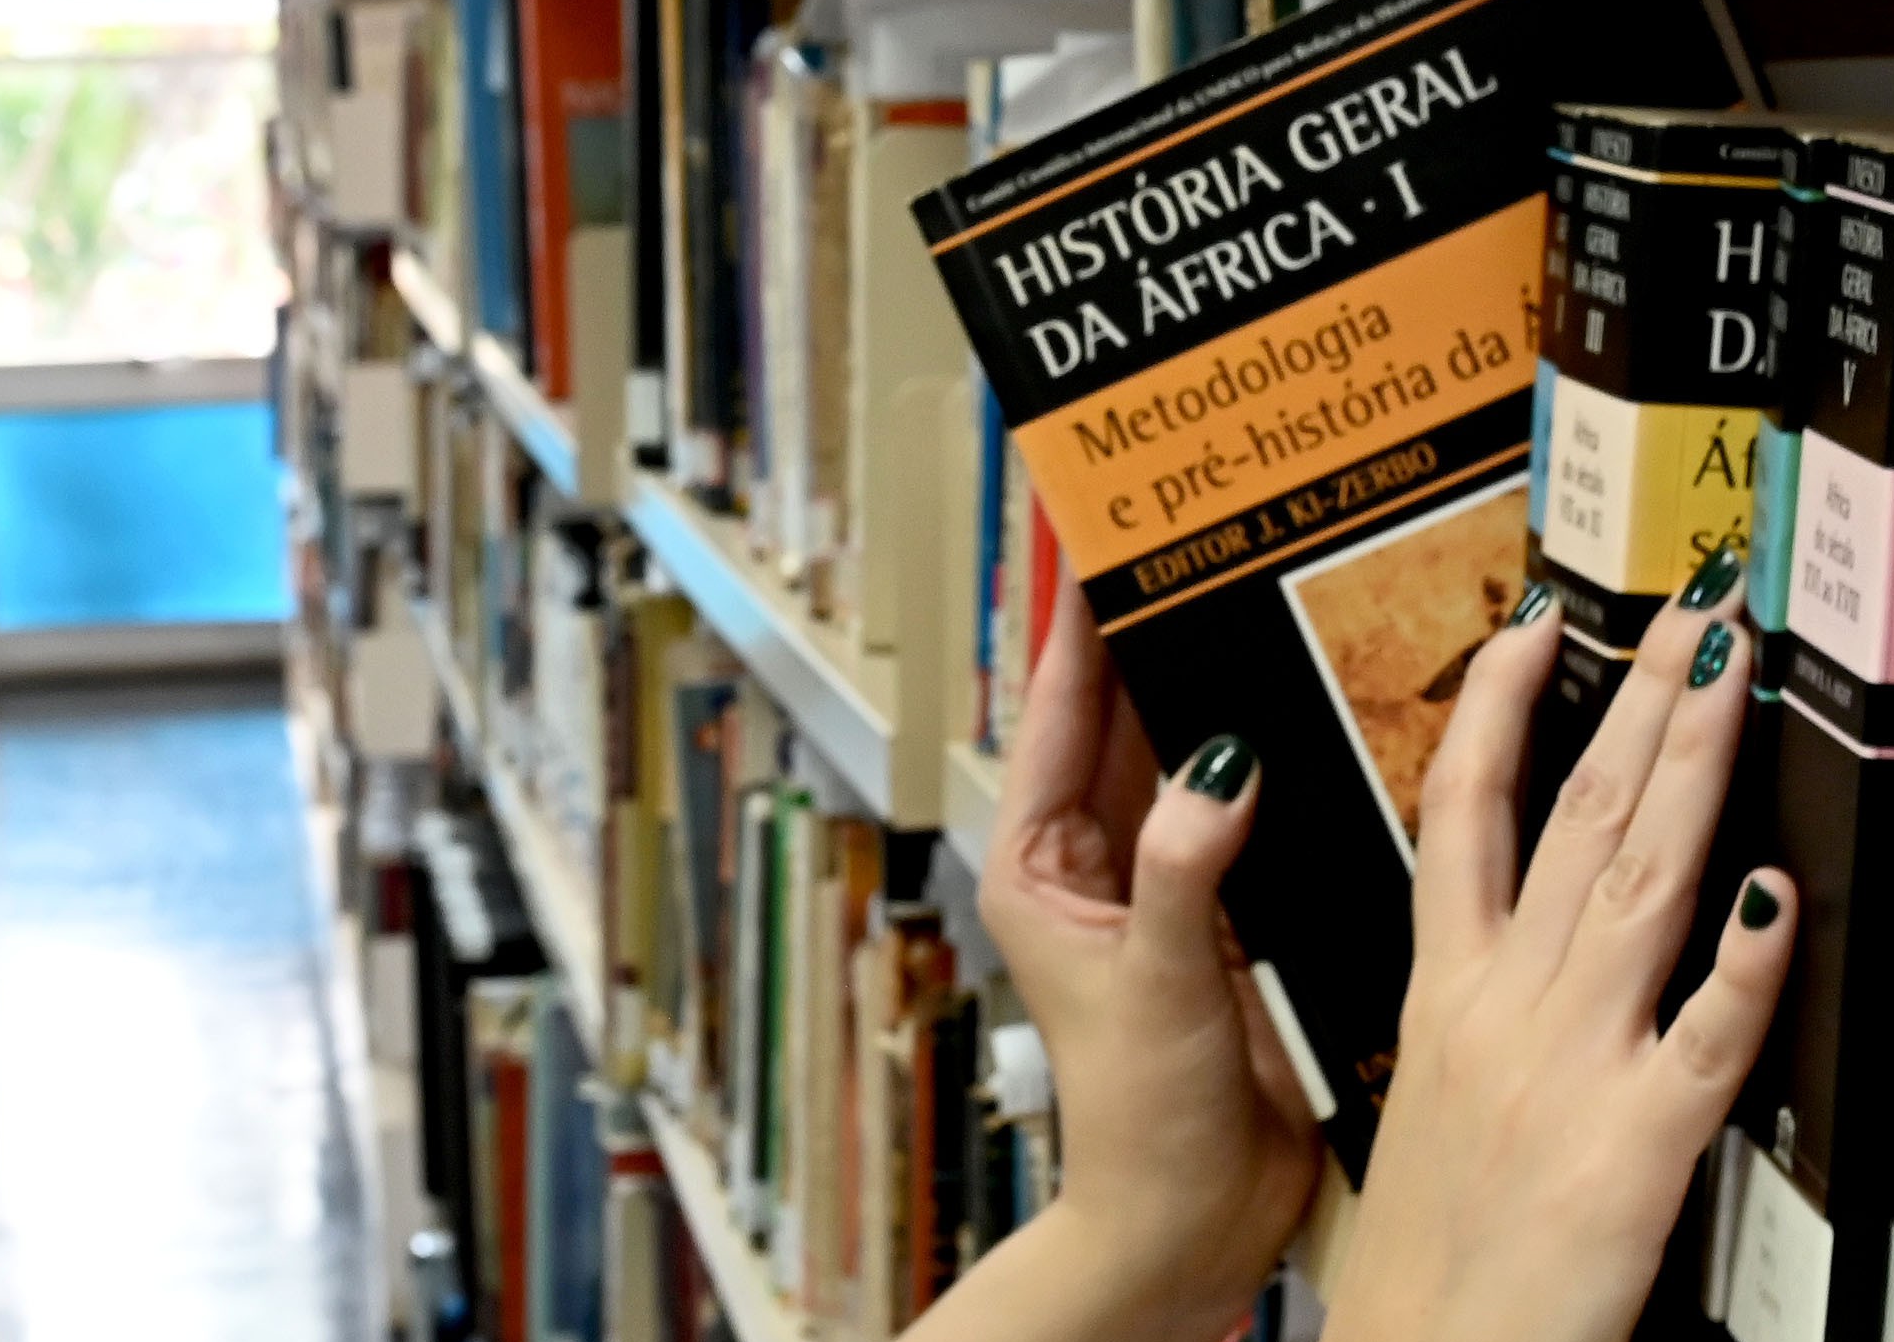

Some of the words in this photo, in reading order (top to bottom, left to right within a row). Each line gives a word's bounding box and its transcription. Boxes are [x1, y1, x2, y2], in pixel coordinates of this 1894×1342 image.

[995, 143, 1283, 308] HISTÓRIA
[1287, 45, 1500, 174] GERAL
[1025, 300, 1129, 380] DA
[1135, 196, 1356, 337] ÁFRICA
[1070, 299, 1392, 467] Metodologia
[1108, 493, 1137, 531] e
[1151, 361, 1439, 524] pré-história
[1447, 327, 1511, 383] da
[1133, 519, 1255, 596] EDITOR
[1286, 442, 1438, 527] KI-ZERBO
